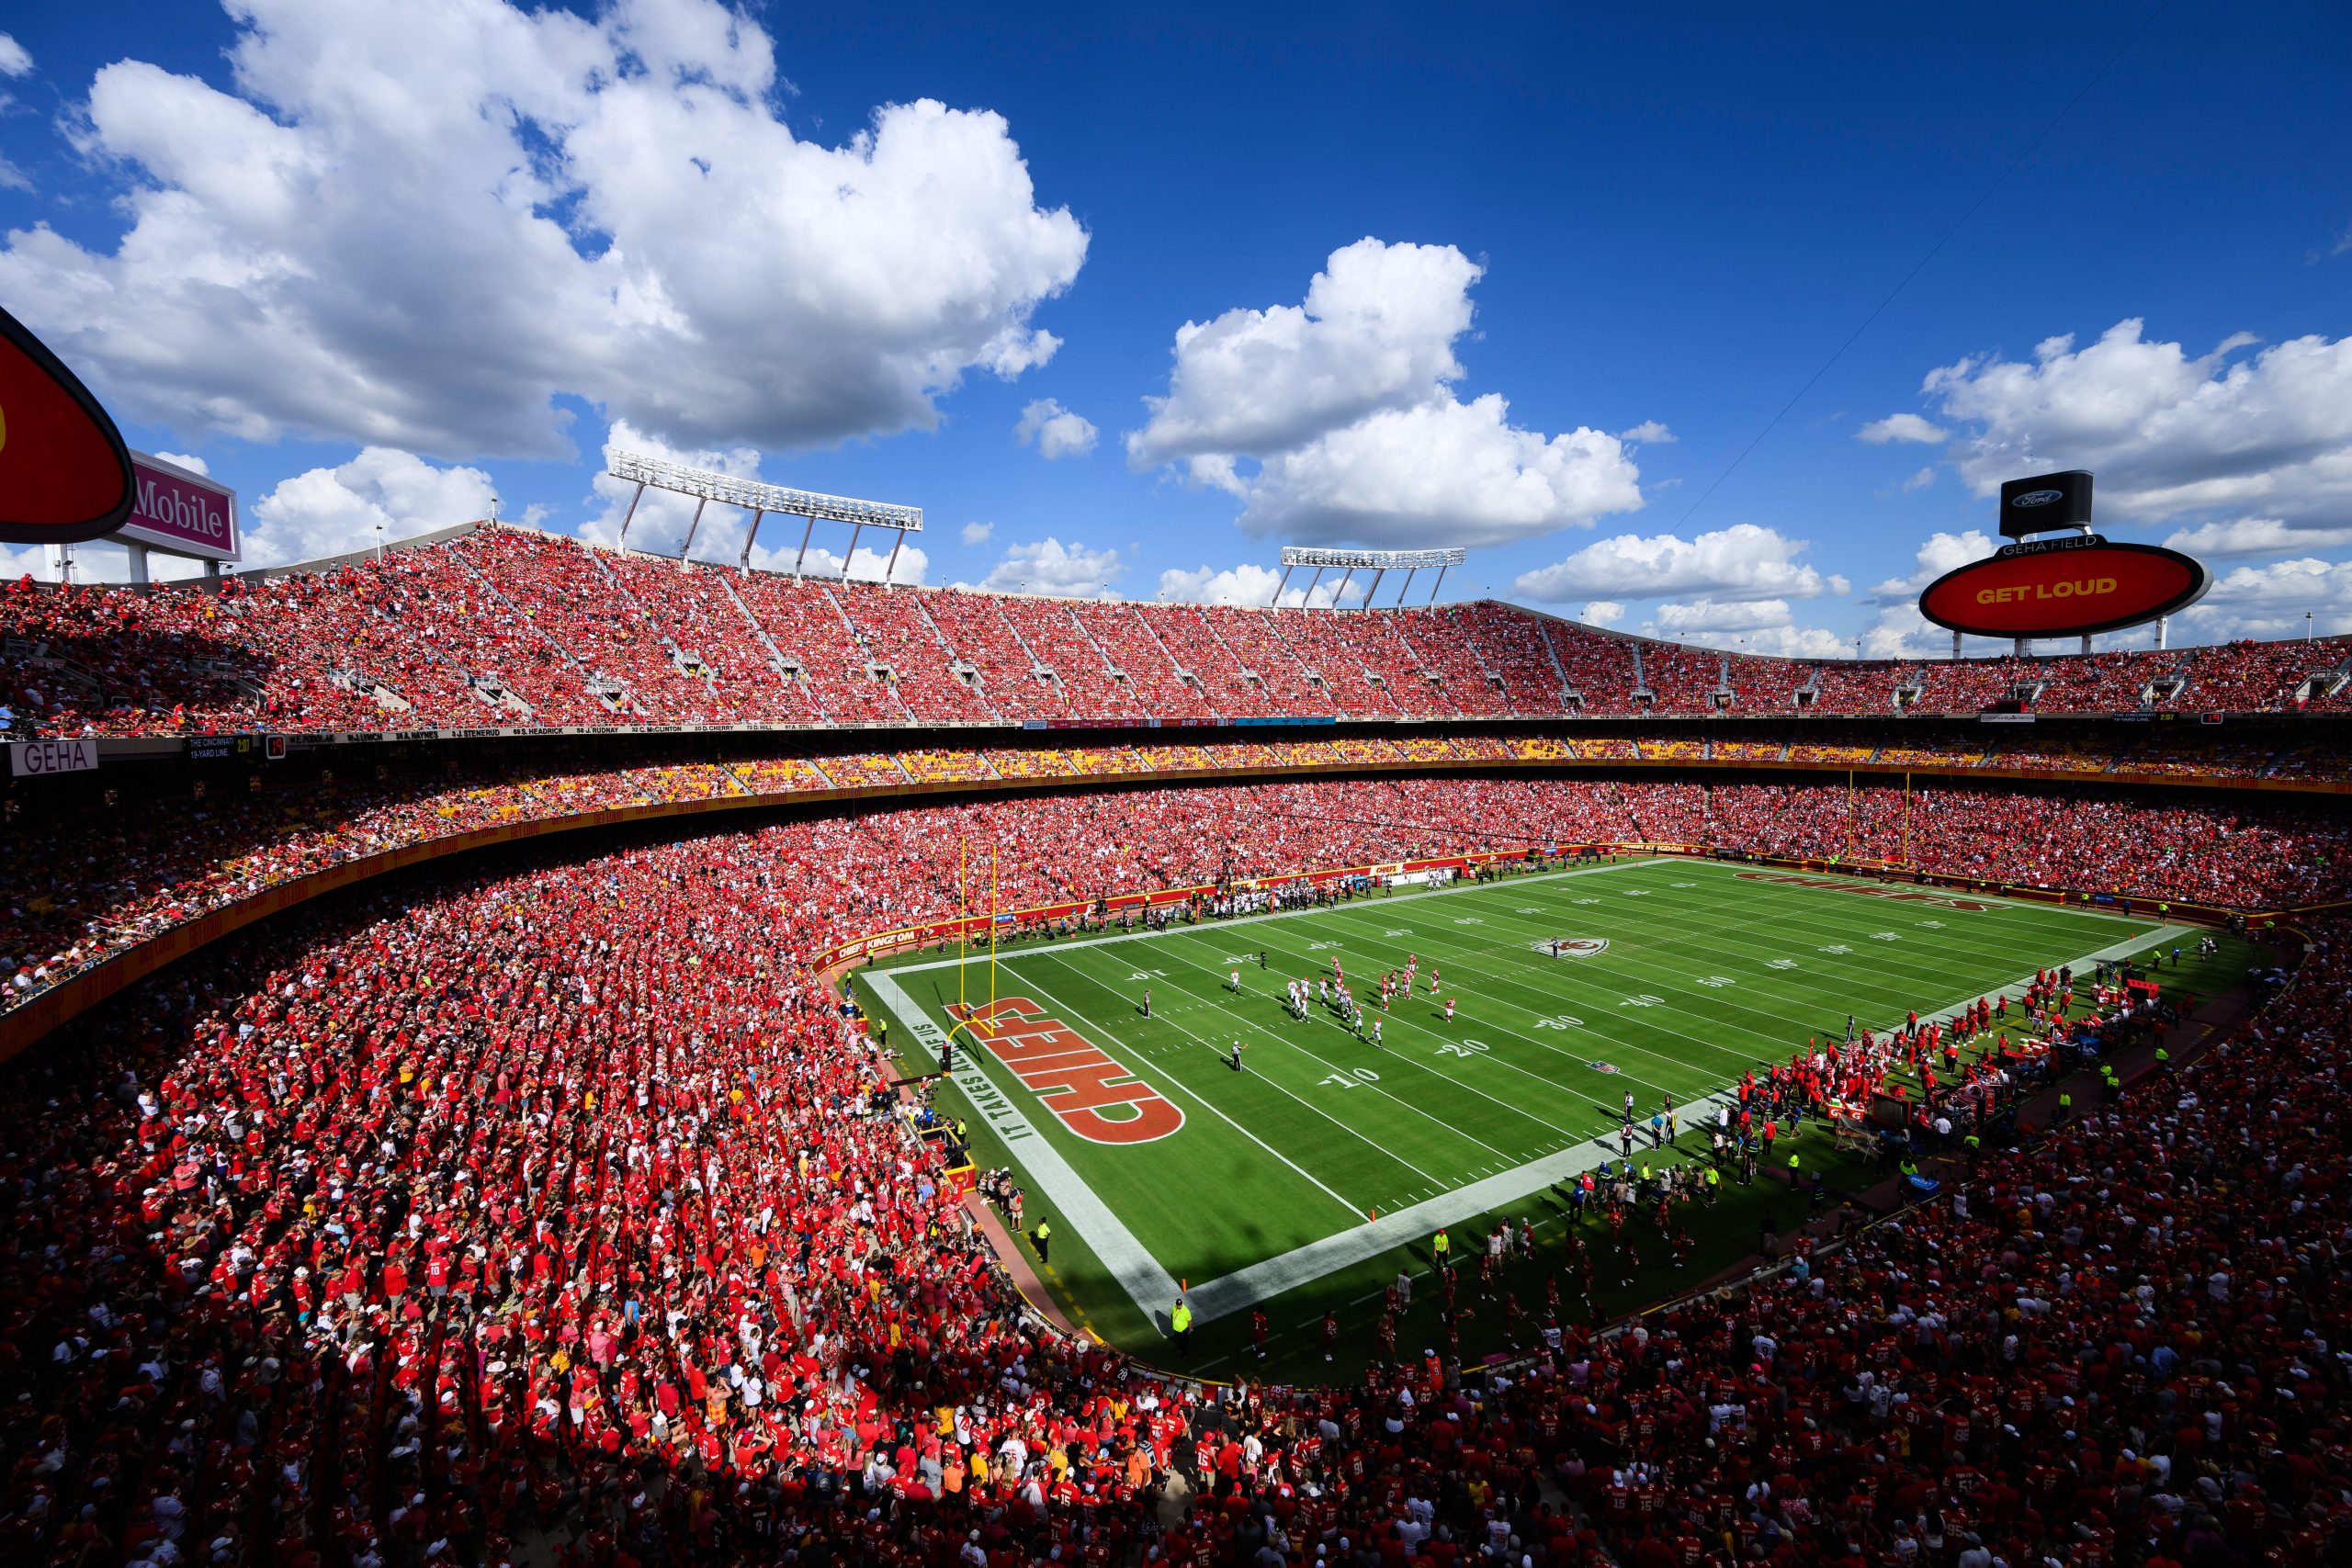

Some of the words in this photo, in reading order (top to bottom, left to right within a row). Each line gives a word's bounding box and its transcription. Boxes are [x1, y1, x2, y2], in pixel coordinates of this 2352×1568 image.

[2021, 492, 2052, 506] Ford
[2003, 542, 2046, 556] GEHA
[2052, 536, 2097, 550] FIELD
[1976, 585, 2030, 604] GET
[2037, 578, 2118, 600] LOUD
[2208, 714, 2221, 722] 19
[360, 732, 383, 742] LYNCH
[411, 730, 438, 739] HAYNES
[463, 728, 500, 737] STENERUD
[528, 727, 563, 735] HEADRICK
[190, 739, 202, 748] THE
[202, 737, 234, 747] CINCINNATI
[237, 739, 250, 753] 2:07
[272, 738, 284, 754] 19
[24, 742, 88, 773] GEHA
[191, 750, 214, 760] 19-YARD
[215, 748, 230, 757] LINE.
[2021, 768, 2035, 778] GET
[2037, 768, 2053, 779] LOUD
[2115, 773, 2129, 783] GET
[2131, 773, 2149, 784] LOUD
[2219, 776, 2233, 787] GET
[2236, 777, 2257, 788] LOUD
[759, 795, 770, 806] GET
[772, 794, 786, 805] LOUD
[677, 802, 689, 814] GET
[691, 800, 706, 812] LOUD
[594, 811, 606, 824] GET
[608, 809, 623, 822] LOUD
[511, 824, 523, 839] GET
[525, 821, 539, 836] LOUD
[431, 840, 442, 857] GET
[444, 837, 458, 854] LOUD
[357, 860, 368, 878] GET
[370, 856, 384, 874] LOUD
[279, 884, 290, 907] GET
[292, 878, 308, 901] LOUD
[1733, 873, 2012, 912] CHIEFS
[189, 920, 203, 949] GET
[204, 912, 222, 941] LOUD
[1704, 976, 1736, 987] 50
[1626, 994, 1665, 1008] 40
[1538, 1015, 1585, 1030] 30
[912, 1022, 938, 1037] US
[1442, 1039, 1490, 1058] 20
[941, 997, 1186, 1145] CHIEFS
[1326, 1067, 1380, 1089] 10
[960, 1076, 1013, 1122] TAKES
[1830, 1109, 1838, 1117] G
[1851, 1111, 1861, 1121] G
[1000, 1123, 1034, 1142] IT
[431, 1266, 440, 1276] 10
[1102, 1361, 1113, 1372] 87
[1435, 1367, 1440, 1376] 9
[1117, 1368, 1128, 1382] 28
[1368, 1378, 1376, 1387] 15
[1905, 1412, 1920, 1425] 91
[1546, 1427, 1555, 1437] 15
[1640, 1424, 1653, 1435] 95
[1813, 1439, 1821, 1450] 15
[1197, 1452, 1208, 1466] 15
[1353, 1462, 1363, 1475] 91
[1959, 1480, 1973, 1493] 51
[893, 1488, 905, 1499] 26
[1060, 1495, 1070, 1507] 15
[1614, 1498, 1626, 1509] 15
[1640, 1499, 1653, 1511] 15
[1690, 1509, 1705, 1526] 89
[755, 1518, 763, 1532] 9
[1947, 1523, 1963, 1538] 95
[1197, 1555, 1209, 1566] 15
